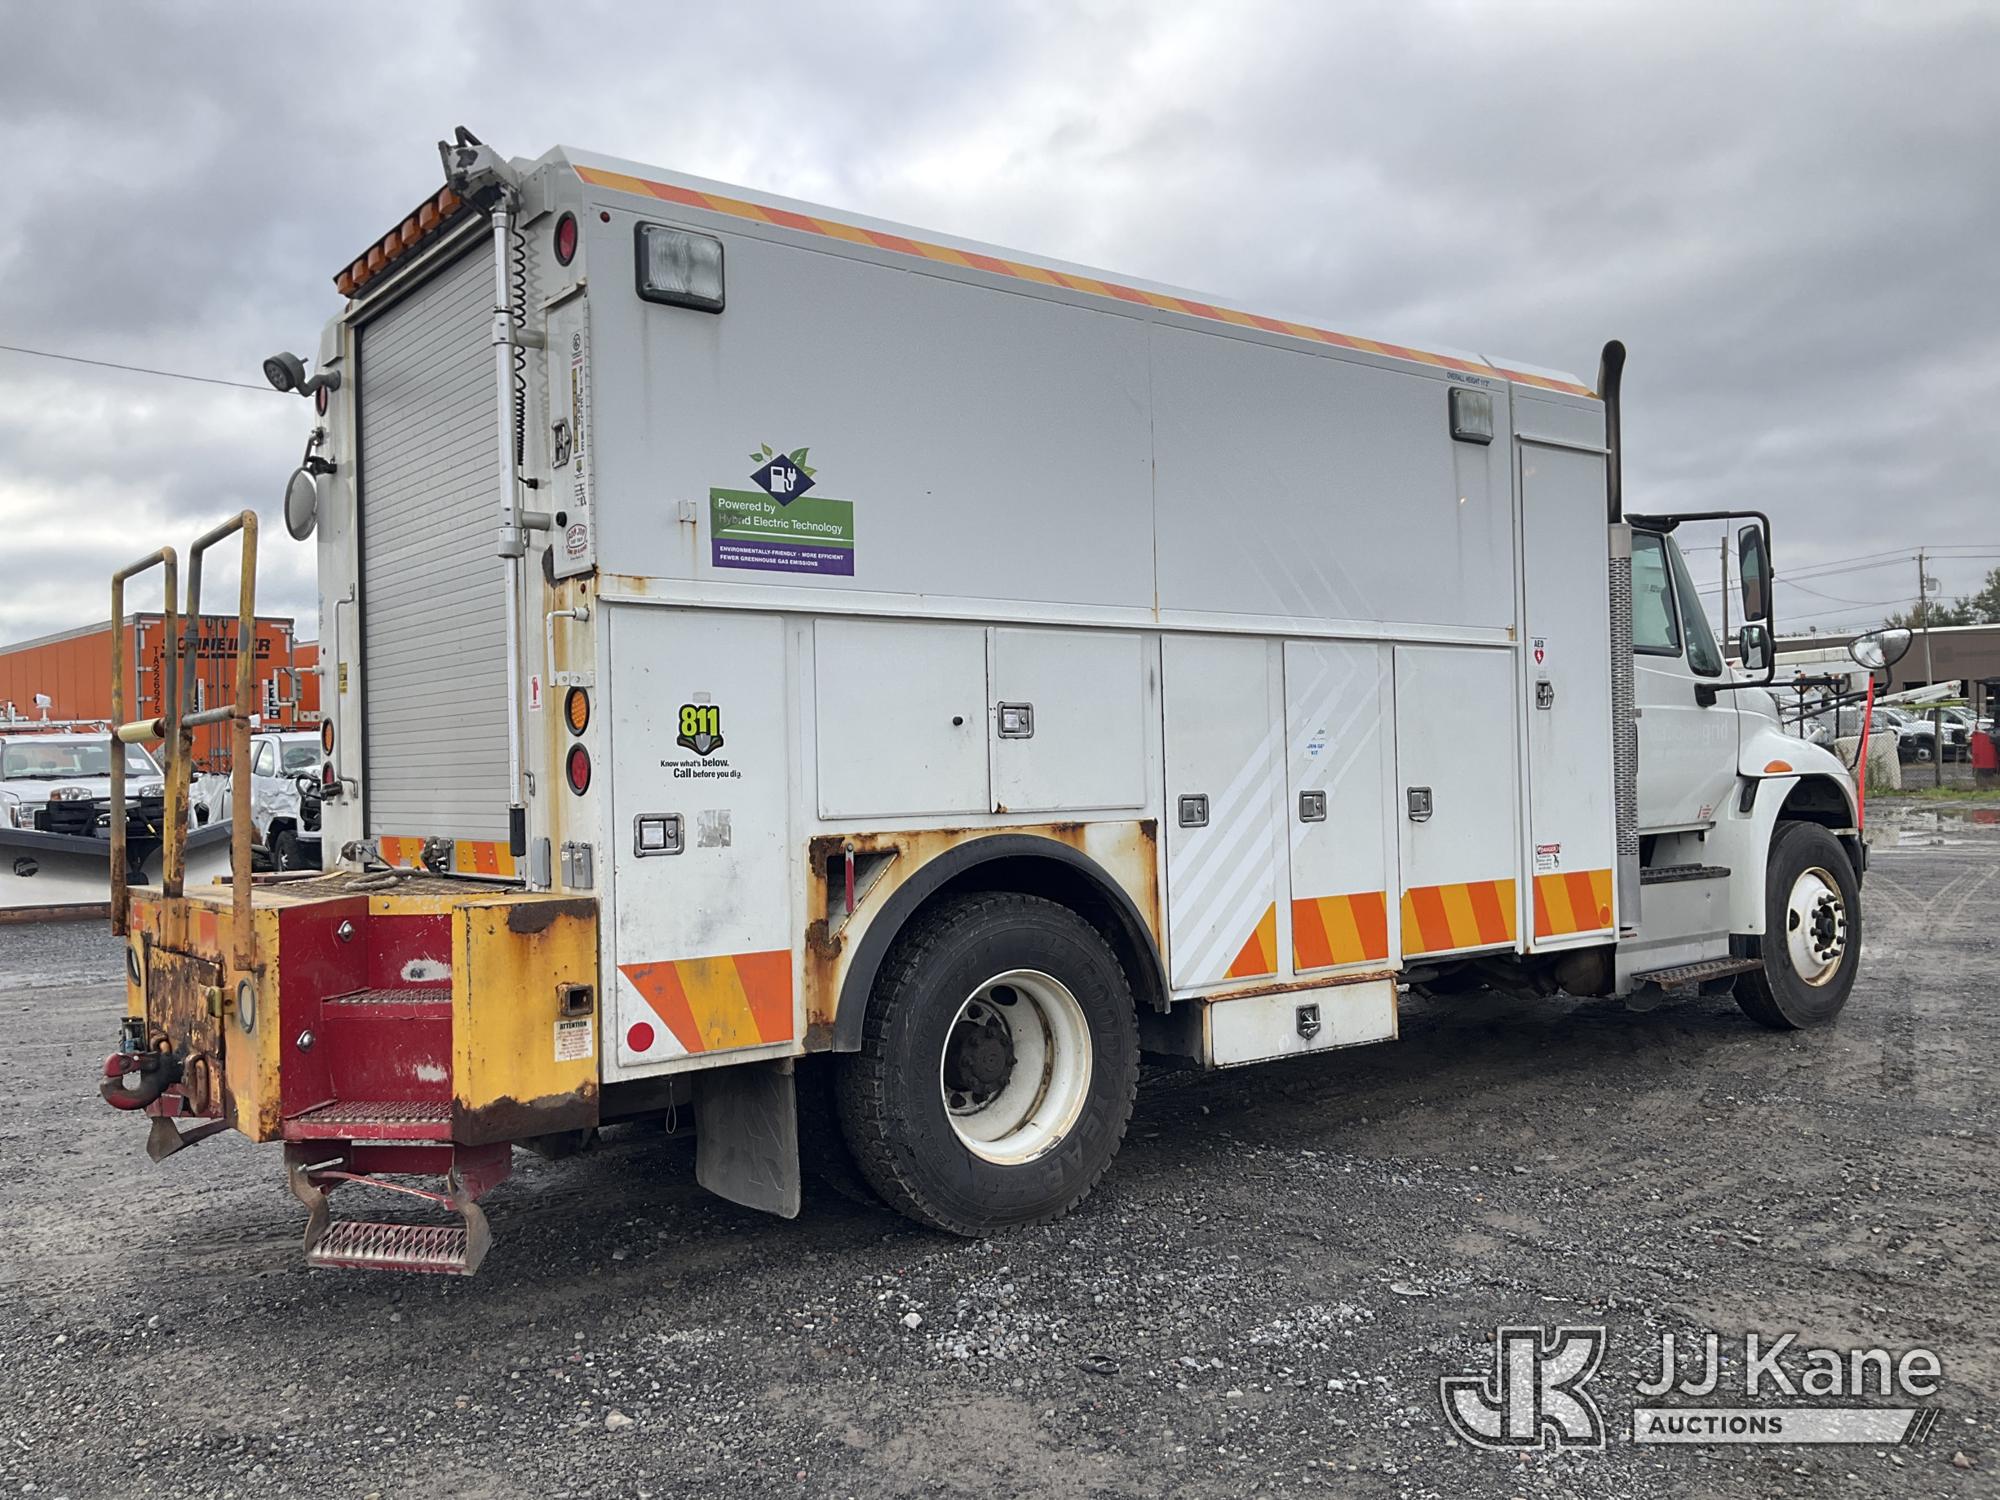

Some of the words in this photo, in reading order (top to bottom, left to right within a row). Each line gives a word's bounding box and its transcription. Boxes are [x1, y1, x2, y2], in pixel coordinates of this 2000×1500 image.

[718, 498, 762, 512] Powered
[763, 502, 776, 514] by
[753, 516, 789, 528] Electric
[791, 520, 843, 535] Technology
[720, 554, 740, 562] FEWER
[740, 555, 777, 564] GREENHOUSE
[790, 559, 818, 567] EMISSIONS
[802, 551, 817, 559] MORE
[1534, 640, 1544, 648] AED
[153, 646, 161, 714] TA226975
[681, 706, 718, 737] 811
[660, 760, 679, 768] Know
[680, 760, 702, 768] what's
[702, 758, 730, 767] below.
[673, 768, 692, 778] Call
[693, 770, 716, 779] before
[560, 1021, 587, 1030] ATTENTION
